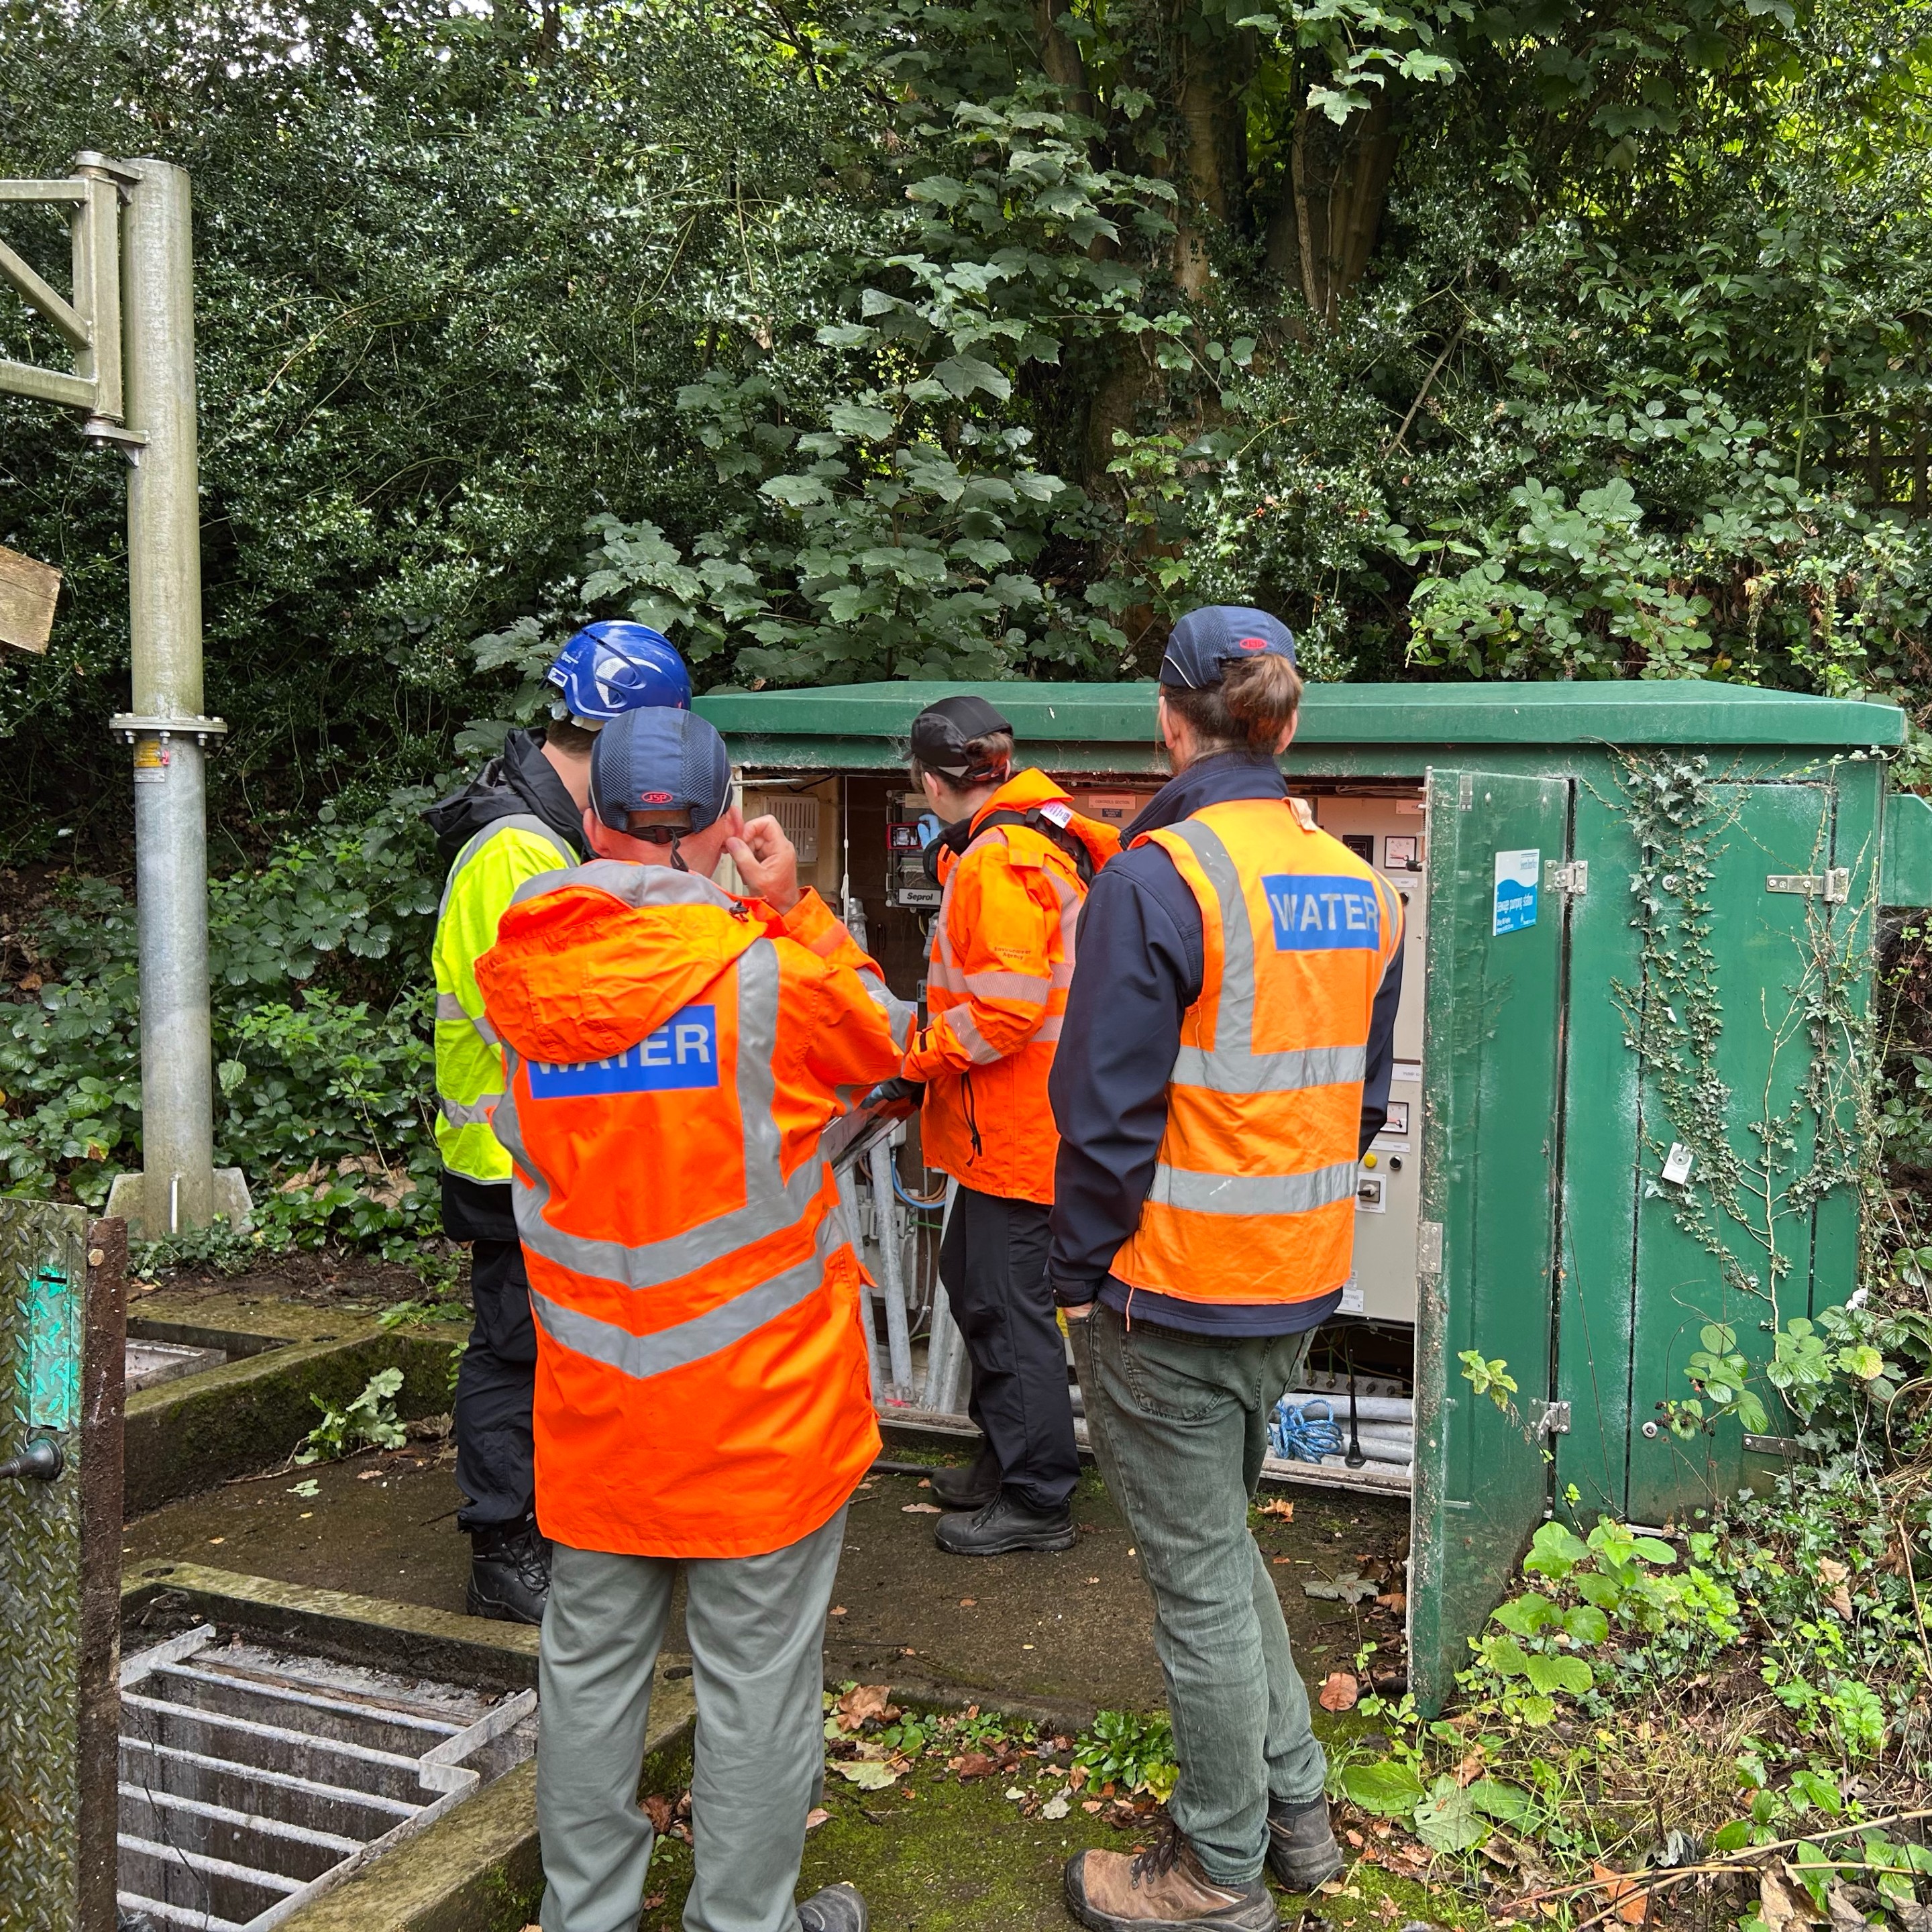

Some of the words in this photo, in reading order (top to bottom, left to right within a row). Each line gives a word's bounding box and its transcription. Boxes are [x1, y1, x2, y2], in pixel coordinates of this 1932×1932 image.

[647, 794, 667, 802] JSP
[907, 892, 933, 902] Seprol
[1270, 894, 1379, 933] WATER
